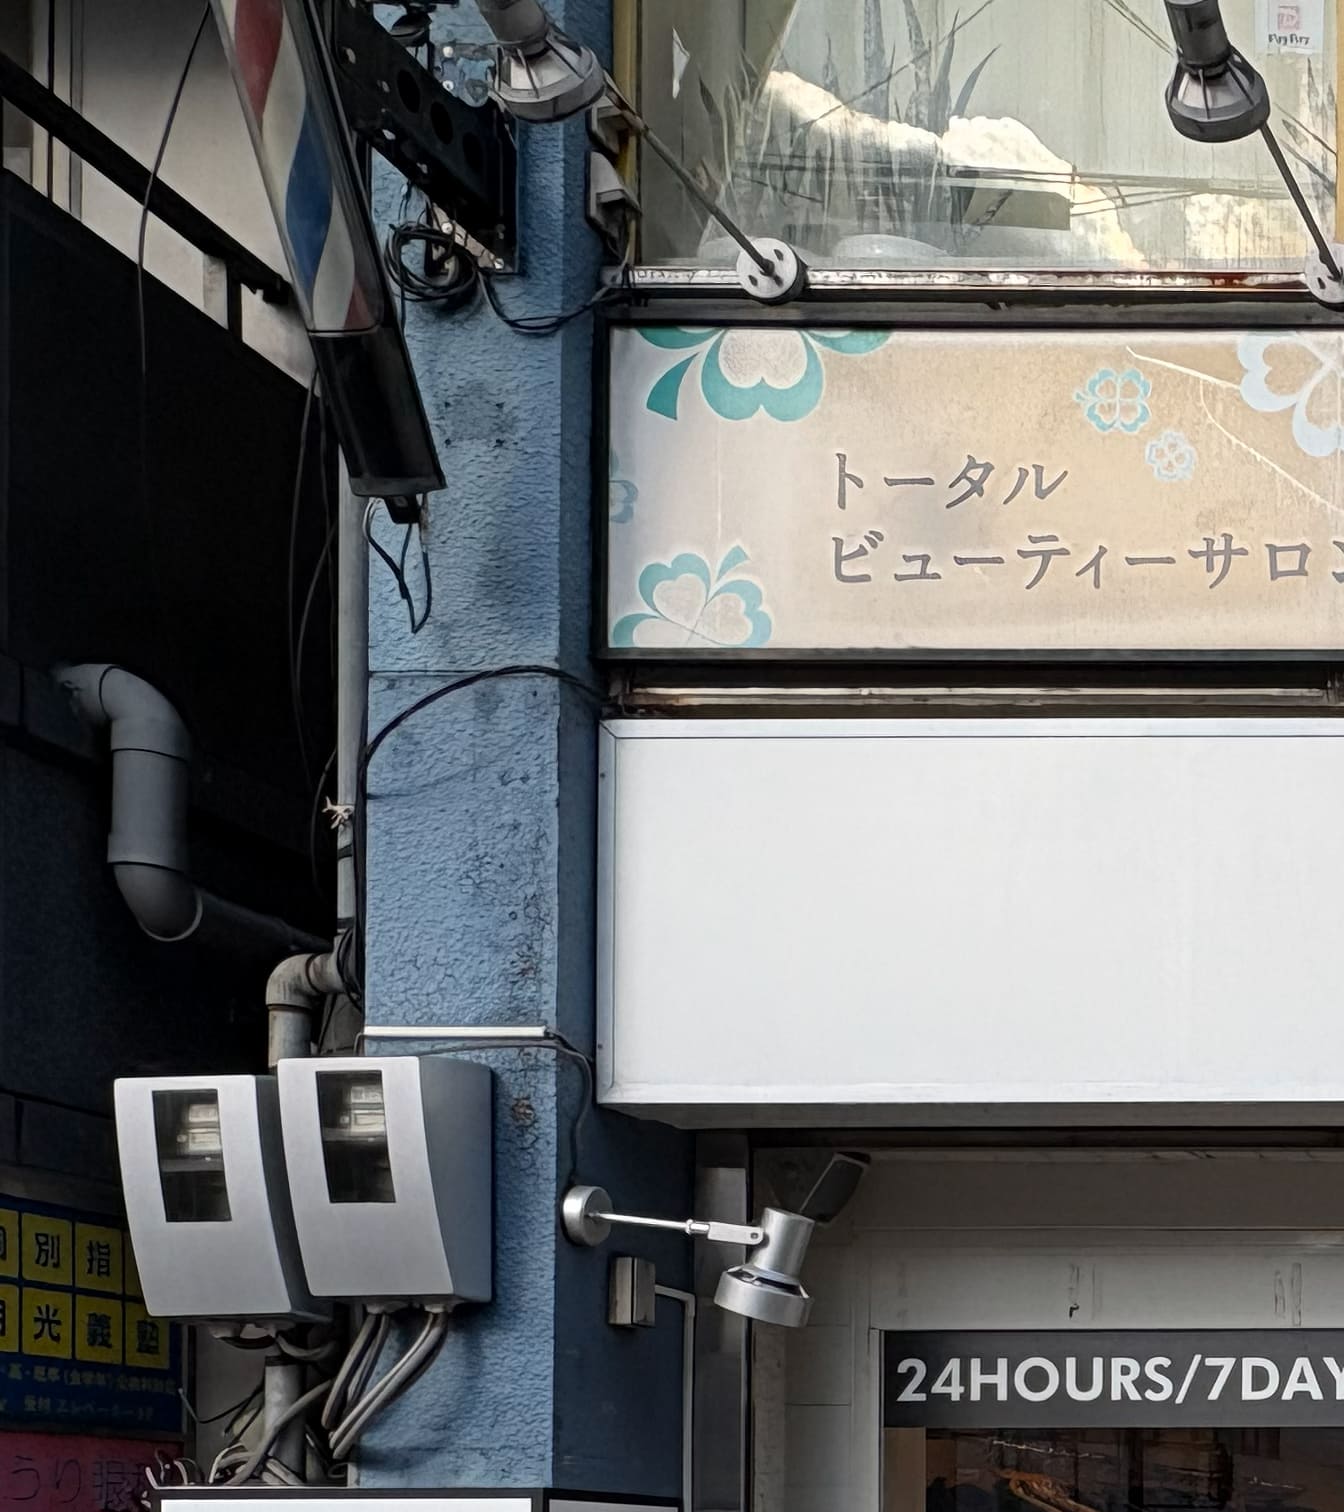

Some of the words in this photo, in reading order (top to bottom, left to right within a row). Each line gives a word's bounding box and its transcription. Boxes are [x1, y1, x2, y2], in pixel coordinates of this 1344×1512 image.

[836, 452, 1068, 510] トータル
[0, 1226, 111, 1277] 別指
